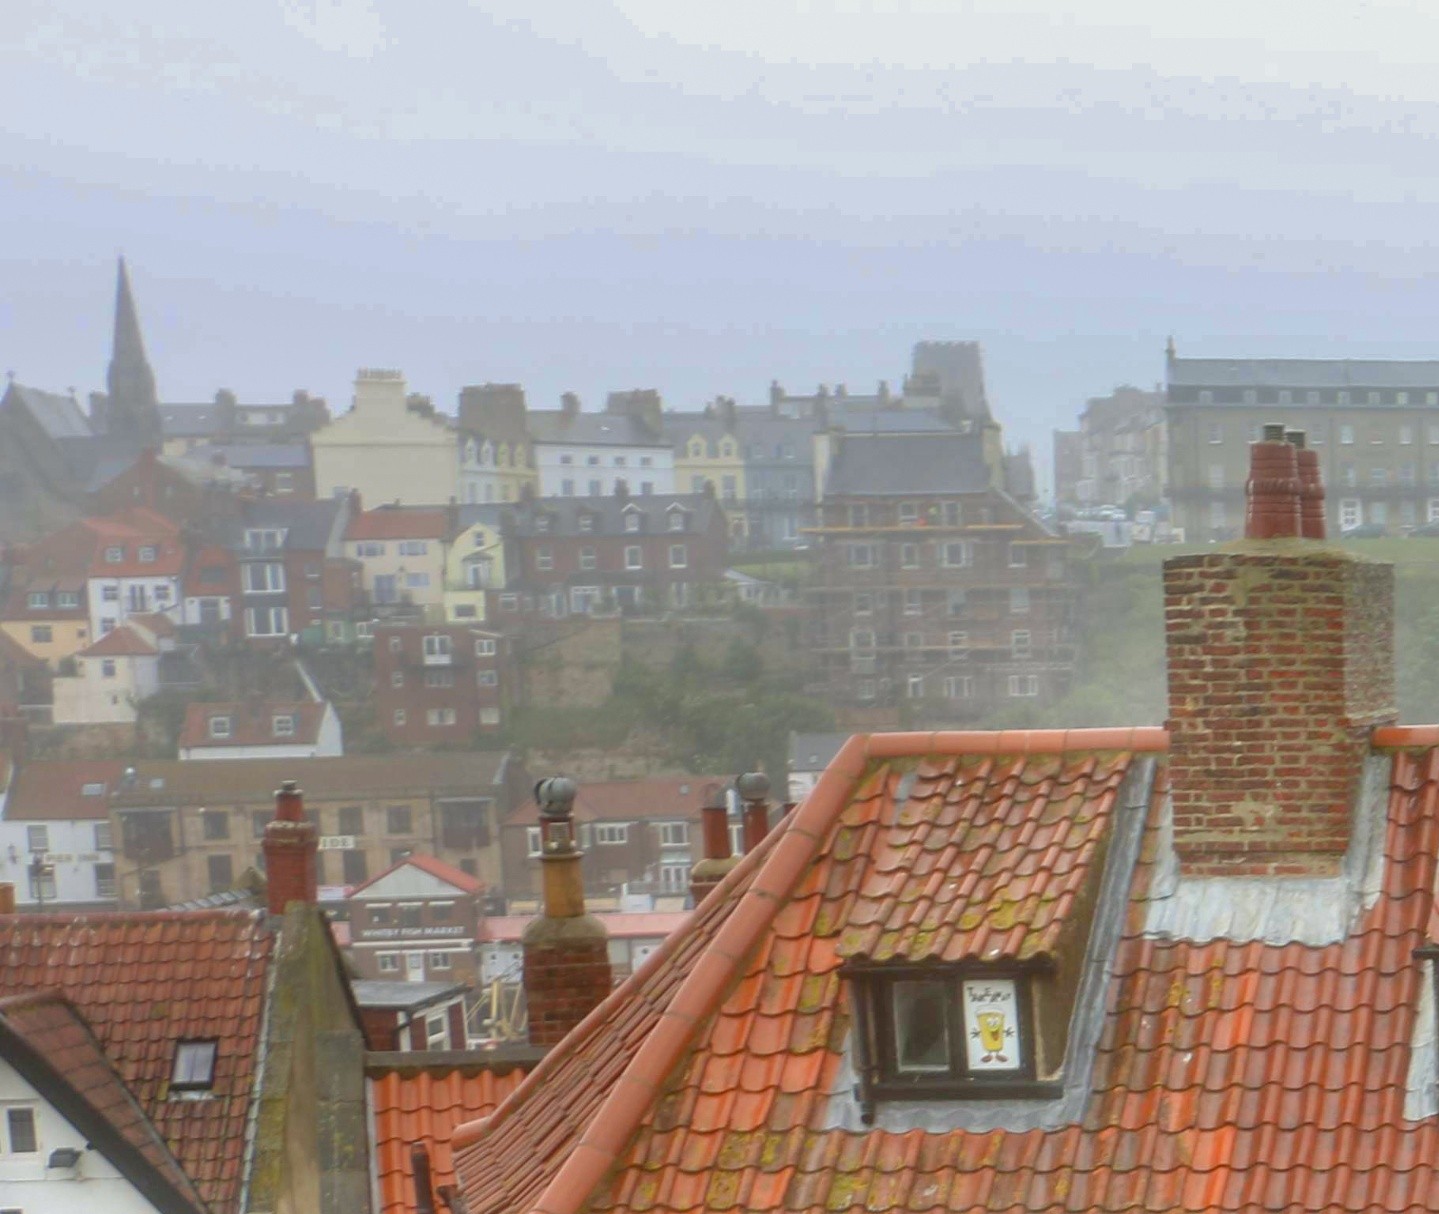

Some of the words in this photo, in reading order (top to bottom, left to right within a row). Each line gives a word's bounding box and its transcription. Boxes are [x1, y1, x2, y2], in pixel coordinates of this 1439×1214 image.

[362, 928, 398, 937] WHITBY
[401, 927, 421, 936] FISH
[424, 926, 464, 935] MARKET
